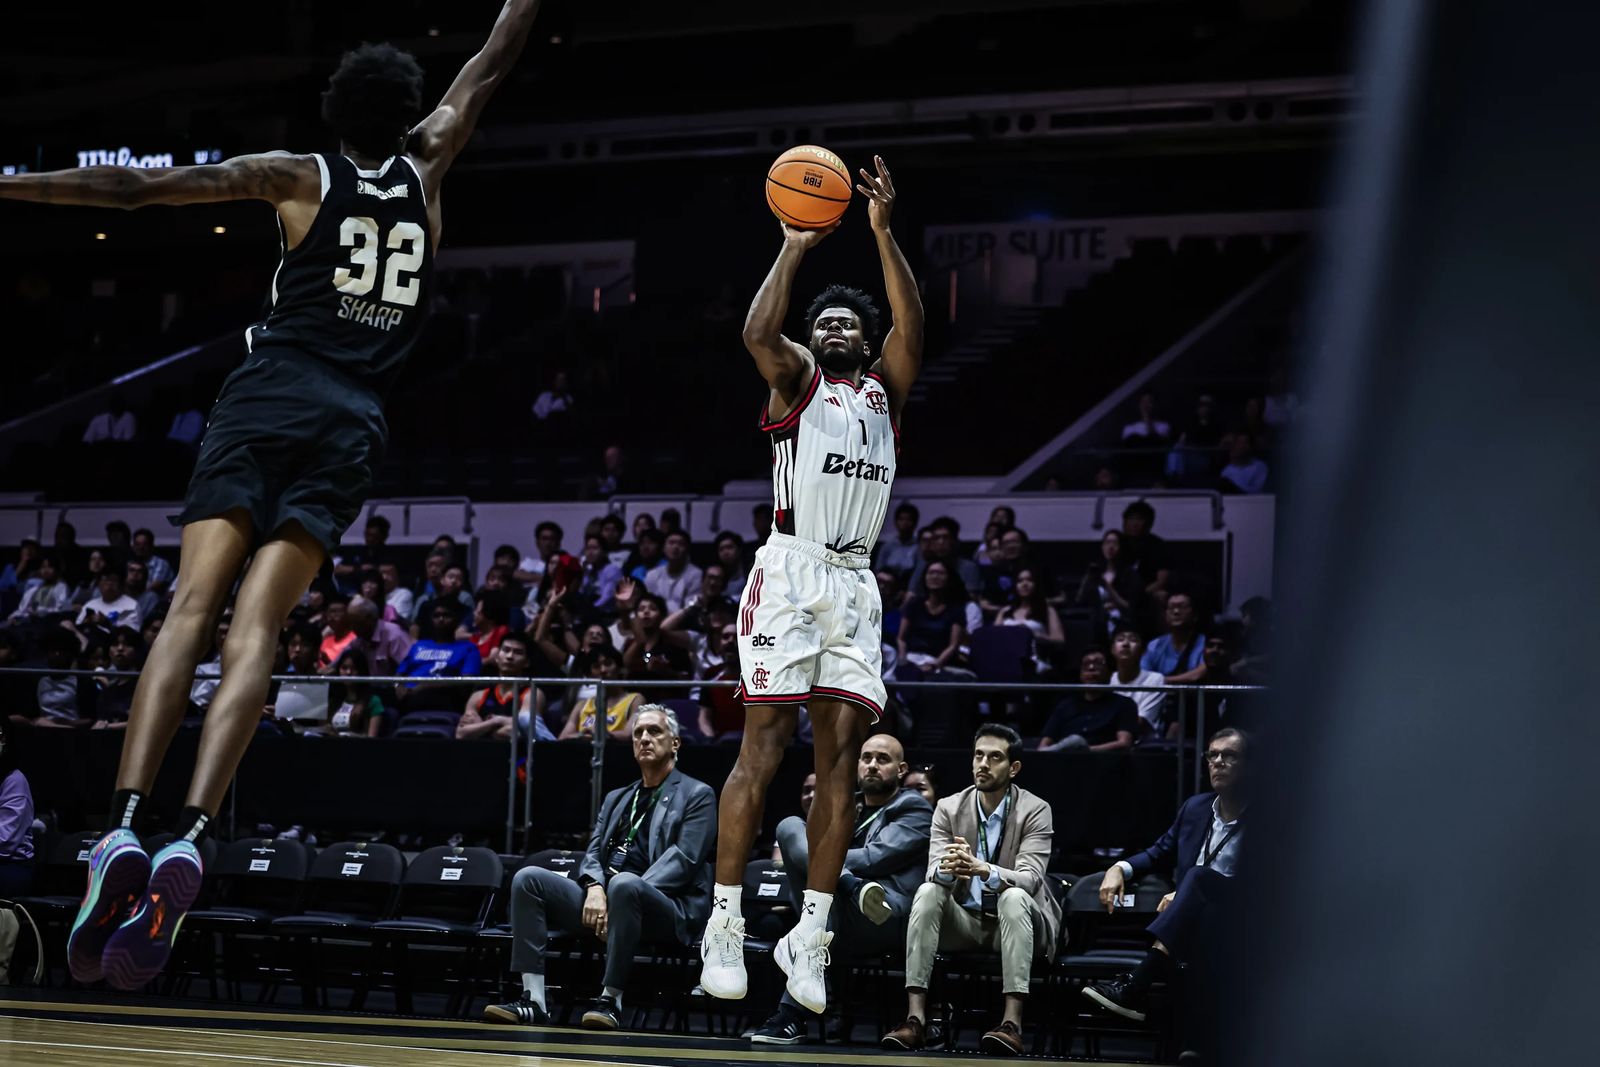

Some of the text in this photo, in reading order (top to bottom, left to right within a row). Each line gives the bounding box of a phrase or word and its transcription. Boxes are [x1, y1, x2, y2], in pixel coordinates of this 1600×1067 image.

[803, 175, 822, 189] FIBA
[332, 216, 425, 307] 32
[337, 295, 403, 331] SHARP
[858, 418, 868, 446] 1
[752, 633, 776, 647] abc
